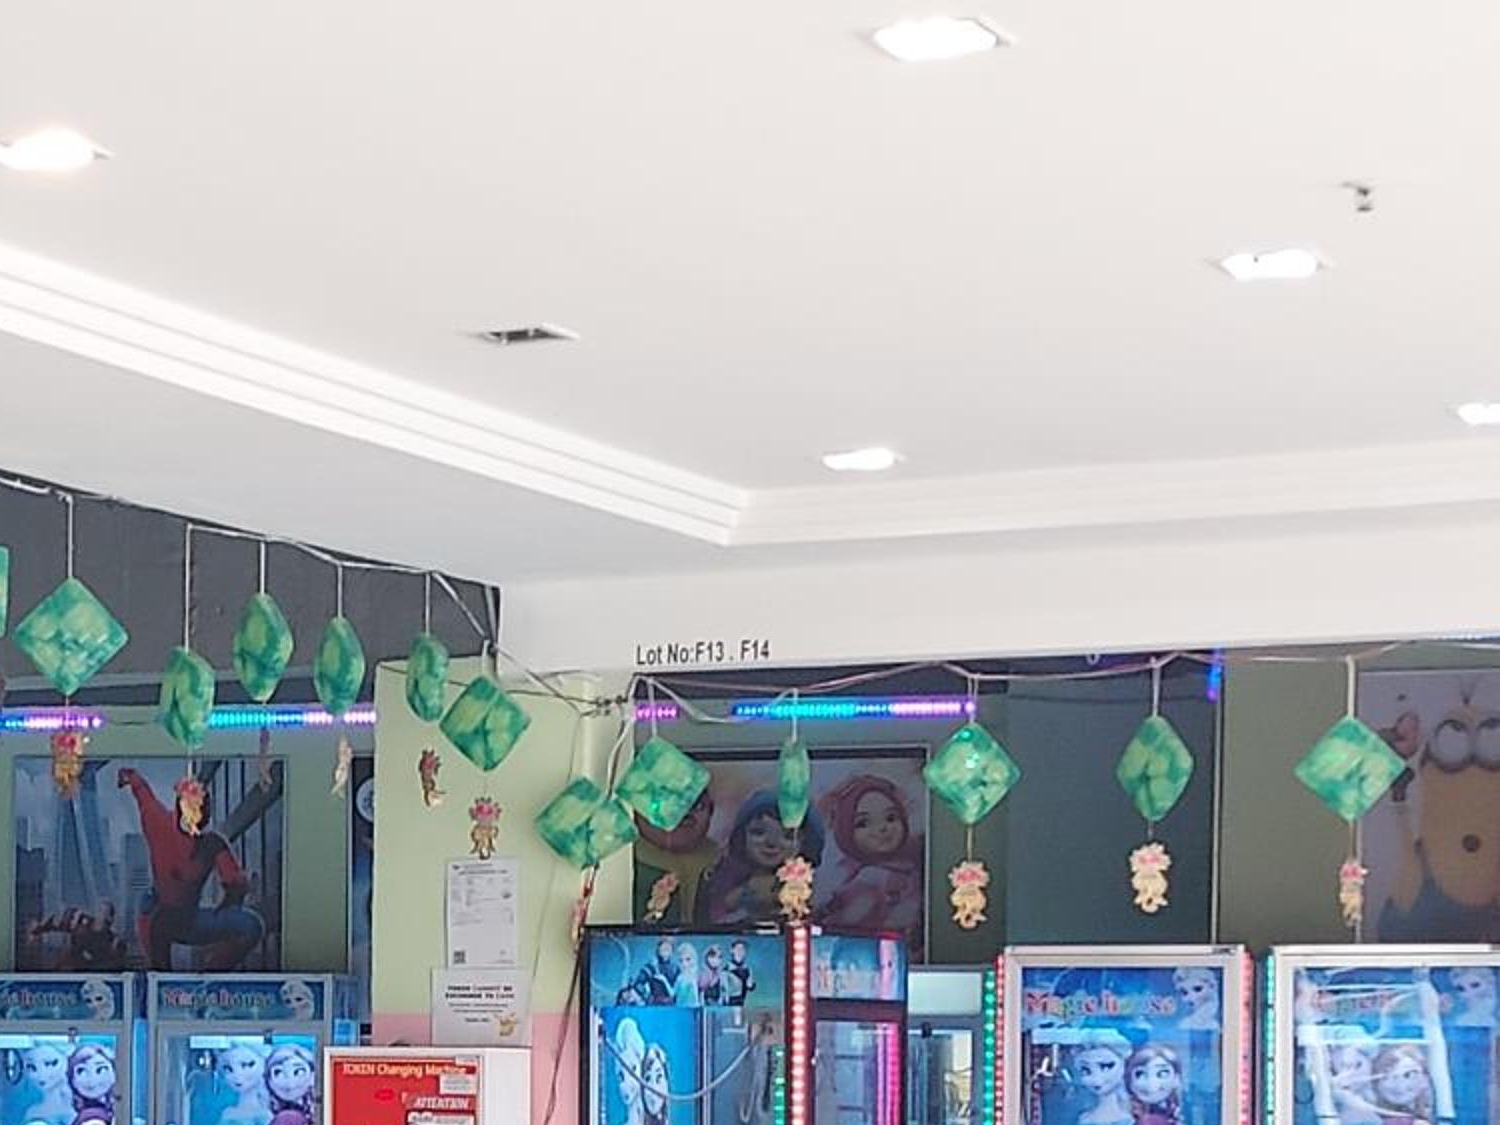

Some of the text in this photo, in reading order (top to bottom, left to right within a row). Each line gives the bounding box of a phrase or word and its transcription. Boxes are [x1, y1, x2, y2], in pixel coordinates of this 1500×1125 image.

[636, 645, 662, 665] Lot
[667, 641, 724, 663] No:F13
[740, 639, 770, 660] F14
[343, 1063, 374, 1075] TOKEN
[377, 1063, 422, 1079] Changing
